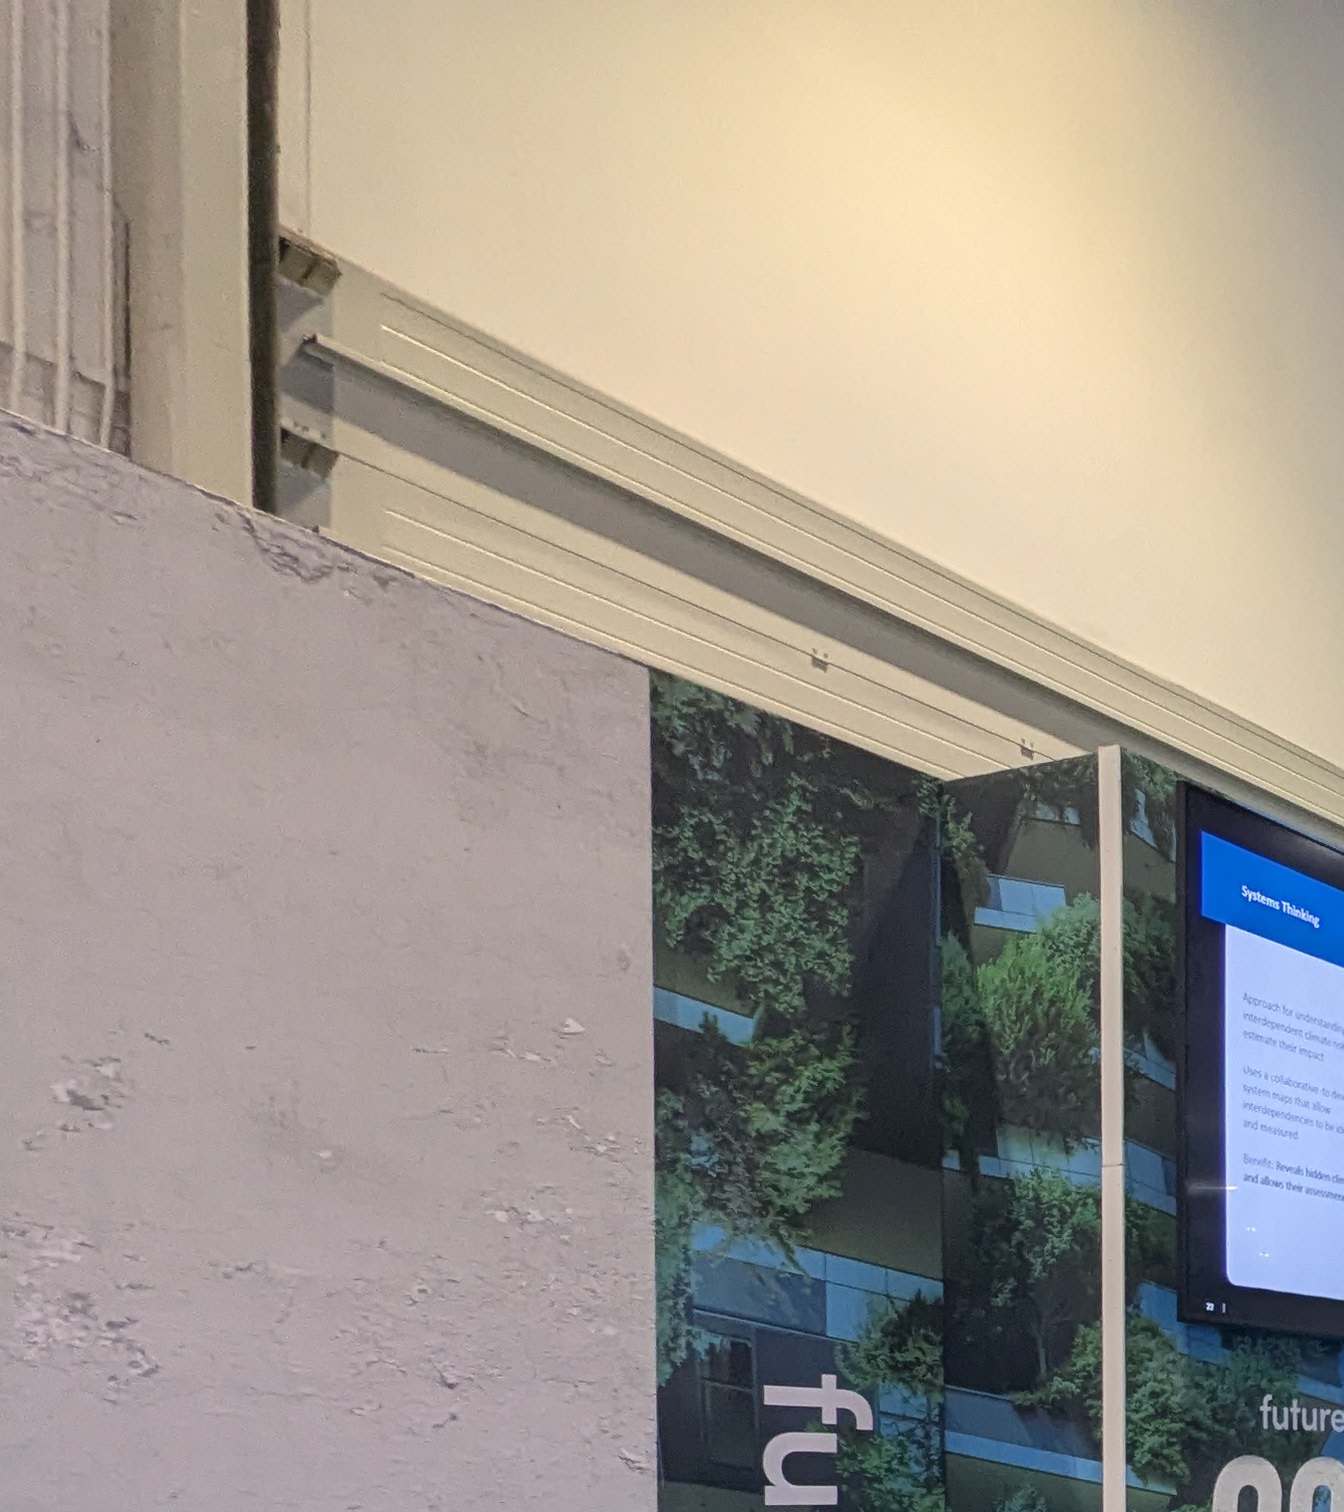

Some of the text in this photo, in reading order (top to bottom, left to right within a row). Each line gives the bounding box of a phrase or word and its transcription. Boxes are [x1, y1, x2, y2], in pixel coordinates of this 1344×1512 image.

[1241, 885, 1320, 928] Systems Thinking
[1243, 992, 1280, 1012] Approach
[1282, 1005, 1293, 1018] for
[1243, 1011, 1303, 1038] interdependent
[1305, 1030, 1332, 1047] climate
[1243, 1029, 1325, 1062] estimate their impact
[1243, 1066, 1262, 1079] Uses
[1270, 1074, 1319, 1094] collaborative
[1243, 1084, 1331, 1114] system maps that allow
[1242, 1100, 1314, 1127] interdependencies
[1315, 1119, 1324, 1129] to
[1325, 1122, 1334, 1132] be
[1243, 1119, 1299, 1140] and measured
[1243, 1153, 1274, 1169] Benefit:
[1275, 1161, 1304, 1177] Reveals
[1305, 1166, 1330, 1182] hidden
[1243, 1172, 1258, 1184] and
[1260, 1175, 1284, 1190] allows
[1285, 1180, 1303, 1193] their
